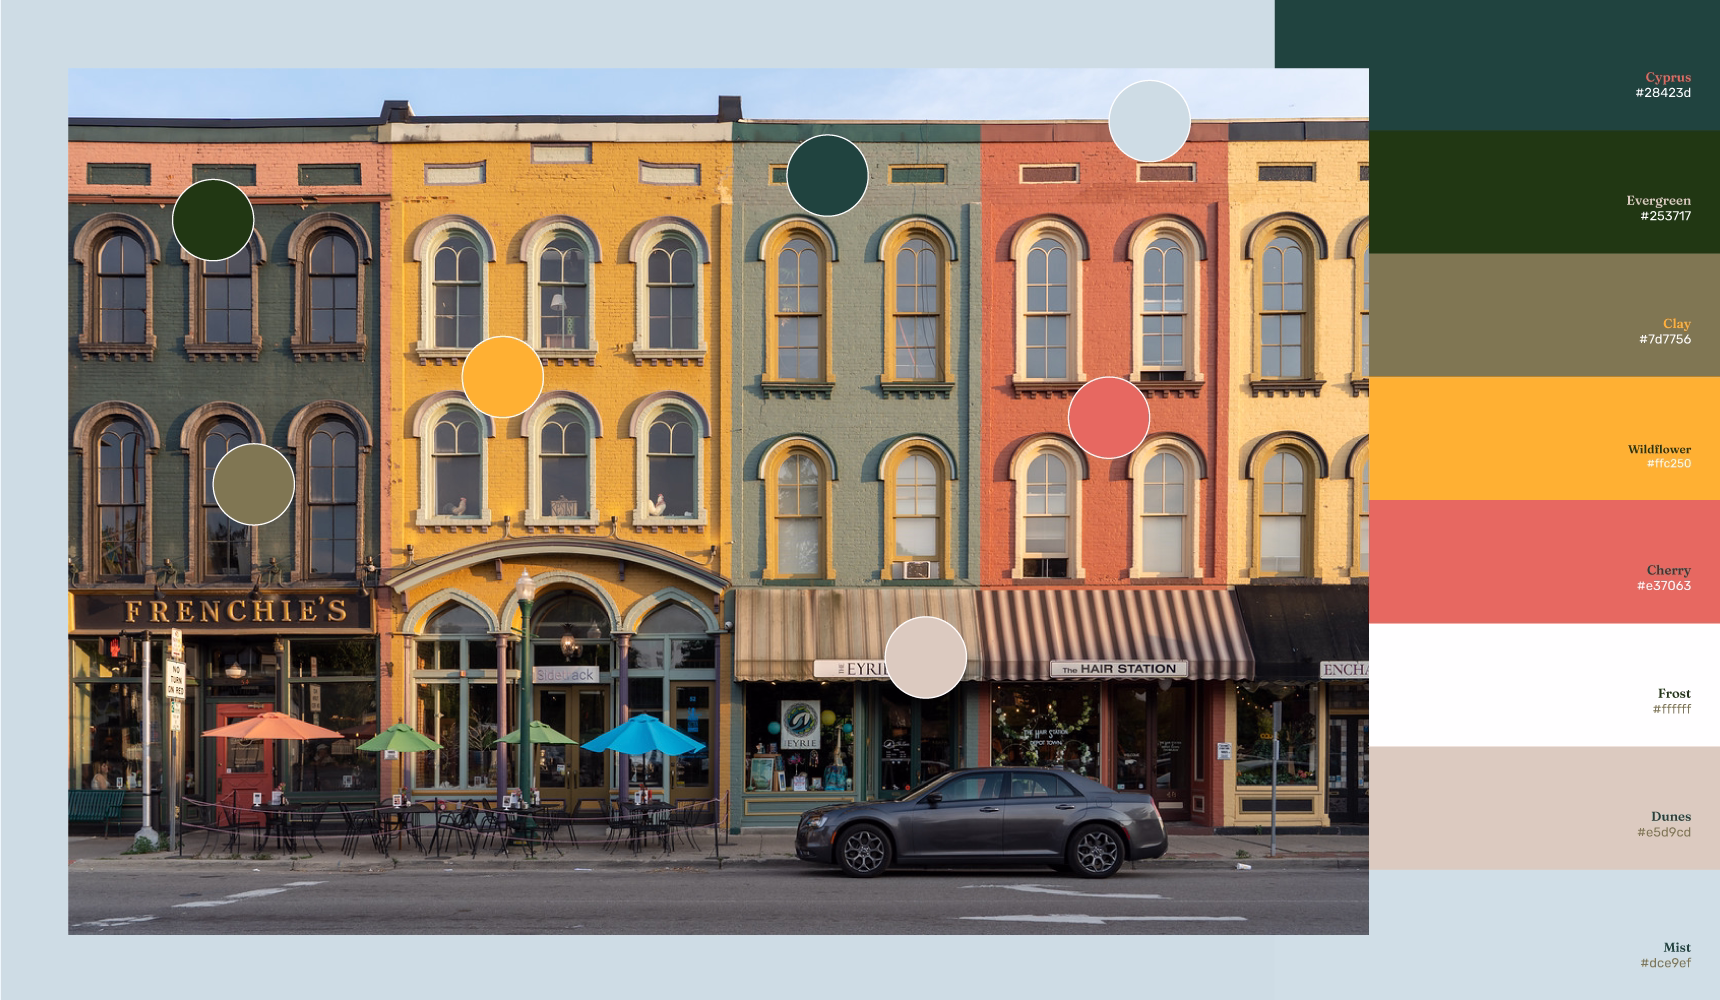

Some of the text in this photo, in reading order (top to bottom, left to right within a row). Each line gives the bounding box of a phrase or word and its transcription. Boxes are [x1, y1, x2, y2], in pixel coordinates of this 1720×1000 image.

[125, 596, 347, 622] FRENCHIE'S
[172, 666, 181, 674] NO
[1081, 664, 1113, 674] HAIR
[1117, 664, 1176, 674] STATION
[170, 675, 183, 684] TURN
[537, 668, 594, 681] Sidetrack
[168, 685, 184, 695] ON RED
